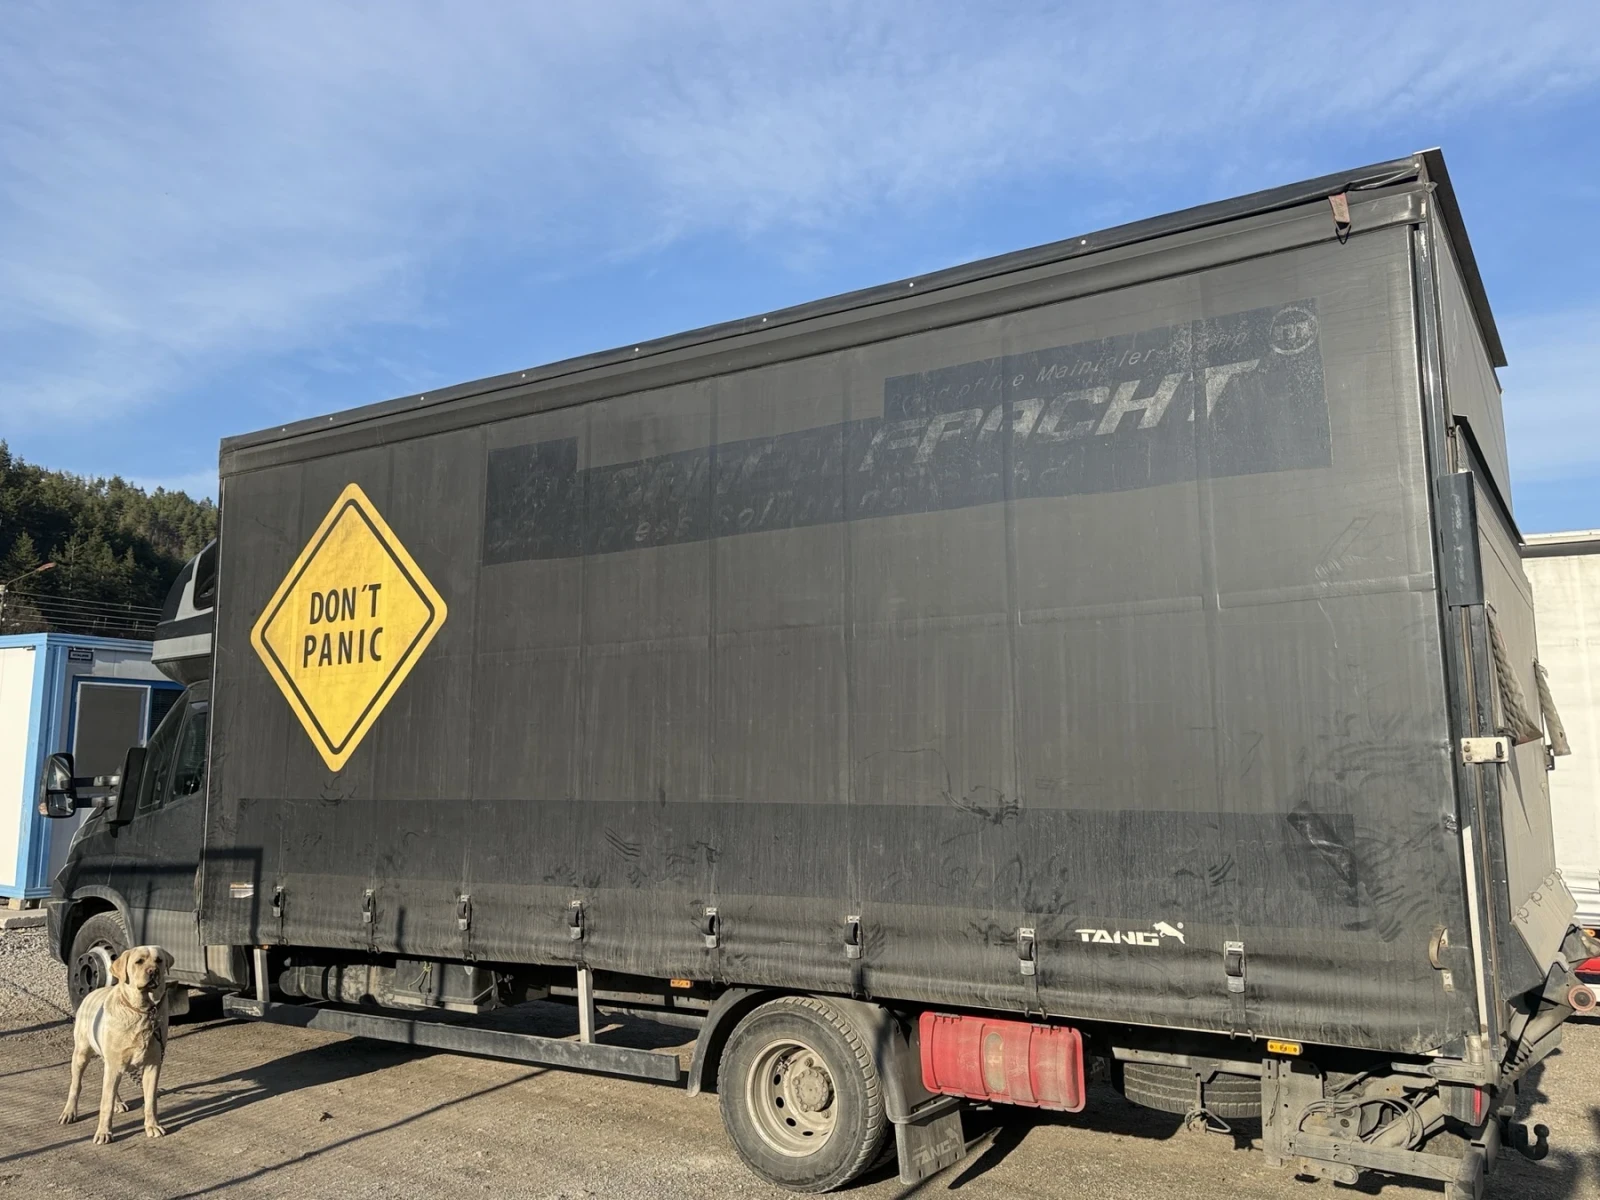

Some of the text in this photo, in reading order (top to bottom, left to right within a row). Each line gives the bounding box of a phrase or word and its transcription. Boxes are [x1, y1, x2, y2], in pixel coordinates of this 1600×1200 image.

[309, 583, 382, 625] DON'T
[302, 626, 383, 669] PANIC
[1074, 929, 1160, 947] TANG
